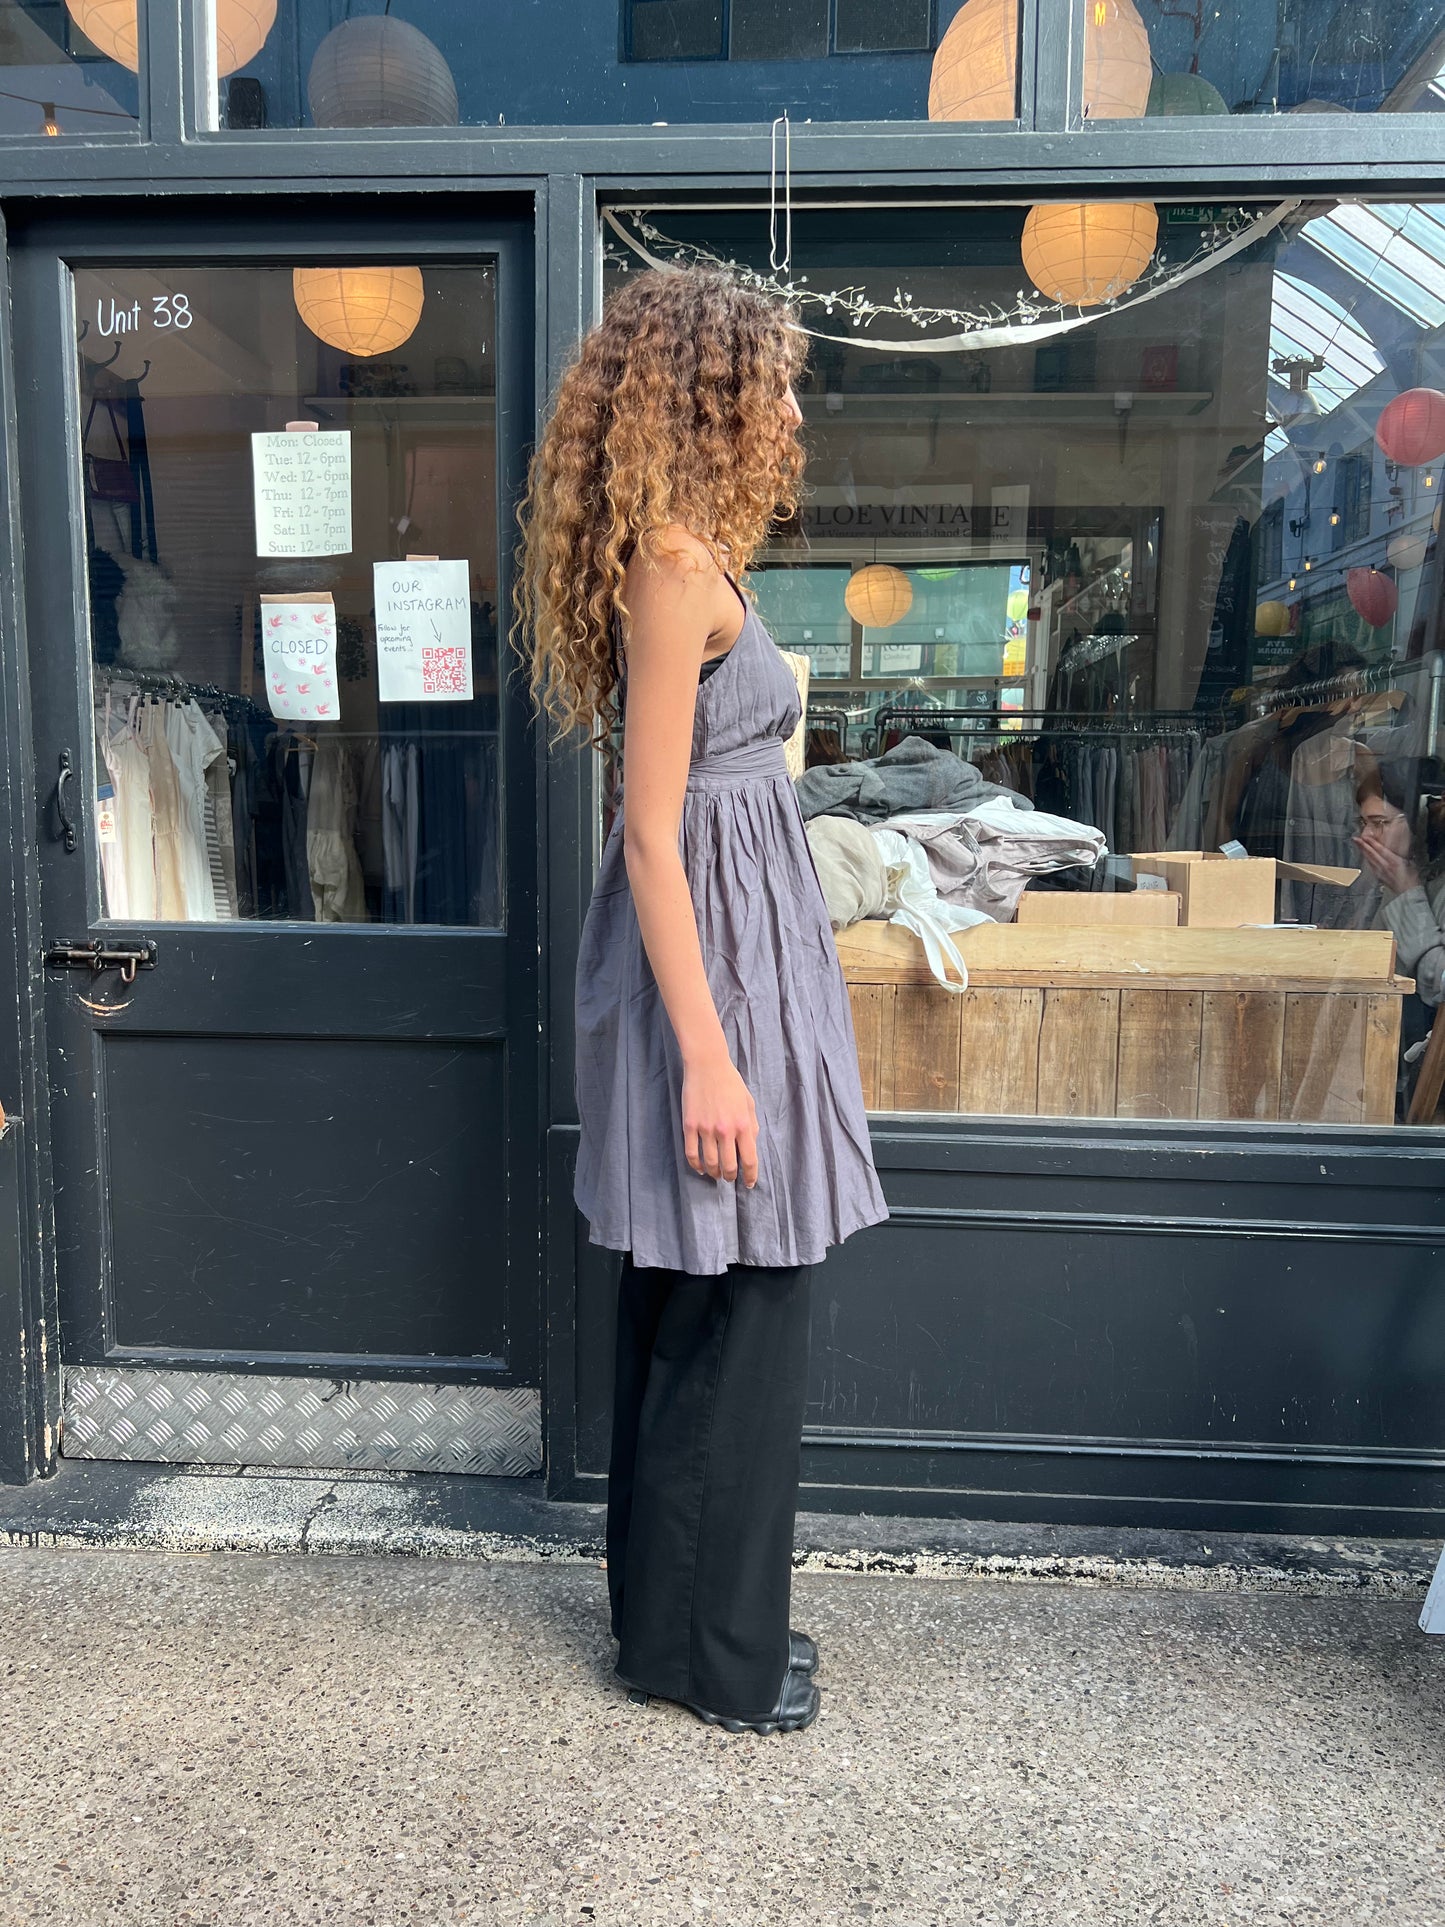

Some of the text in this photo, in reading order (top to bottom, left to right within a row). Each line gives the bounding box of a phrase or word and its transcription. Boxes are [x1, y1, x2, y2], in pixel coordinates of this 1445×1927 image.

[98, 293, 193, 337] Unit 38
[267, 434, 343, 447] Mon: Closed
[265, 453, 293, 465] Tue:
[264, 471, 297, 483] Wed:
[262, 489, 292, 500] Thu:
[273, 506, 294, 518] Fri:
[878, 503, 1010, 527] VINTAE
[273, 524, 296, 535] Sat:
[268, 541, 296, 553] Sun:
[392, 580, 422, 593] OUR
[388, 597, 467, 611] INSTAGRAM
[399, 624, 410, 636] for
[271, 639, 328, 655] CLOSED
[380, 635, 413, 647] upcoming
